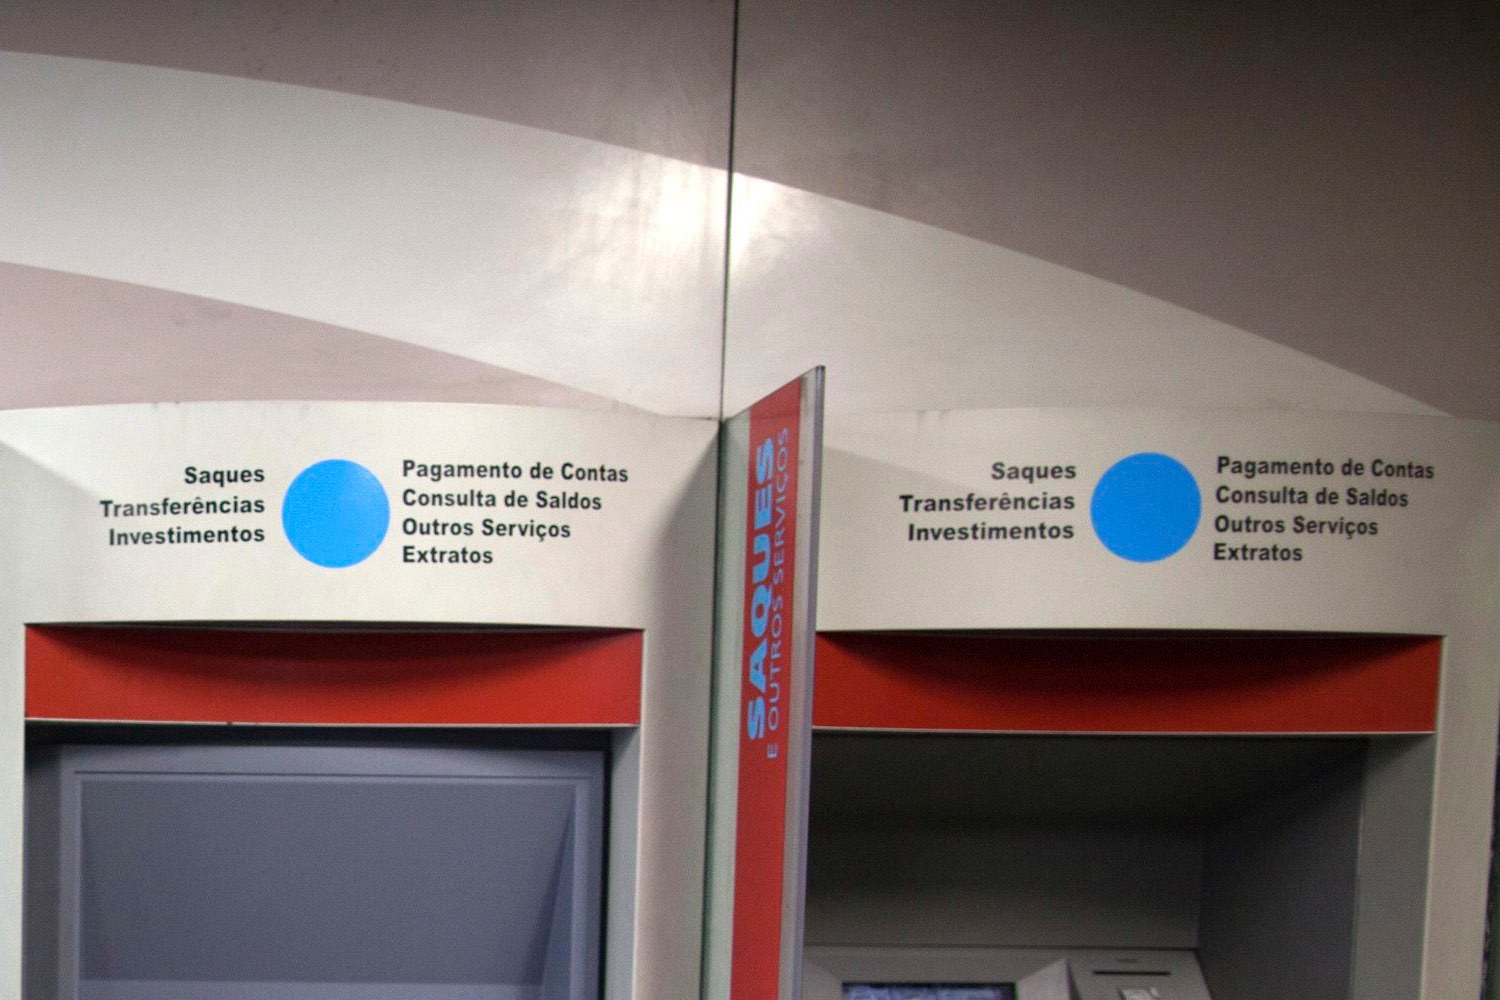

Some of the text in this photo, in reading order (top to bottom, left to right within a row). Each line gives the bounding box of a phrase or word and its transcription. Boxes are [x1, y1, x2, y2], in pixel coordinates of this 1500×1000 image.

[184, 466, 265, 488] Saques
[403, 459, 629, 483] Pagamento de Contas
[991, 462, 1077, 484] Saques
[1217, 456, 1434, 479] Pagamento de Contas
[99, 496, 265, 518] Transferências
[402, 488, 602, 510] Consulta de Saldos
[899, 492, 1075, 512] Transferências
[1215, 485, 1408, 507] Consulta de Saldos
[109, 526, 265, 546] Investimentos
[402, 517, 571, 543] Outros Serviços
[908, 522, 1074, 541] Investimentos
[1214, 514, 1378, 539] Outros Serviços
[402, 545, 493, 564] Extratos
[1213, 542, 1303, 561] Extratos
[748, 438, 774, 739] SAQUES
[768, 595, 783, 731] OUTROS
[767, 743, 779, 758] E
